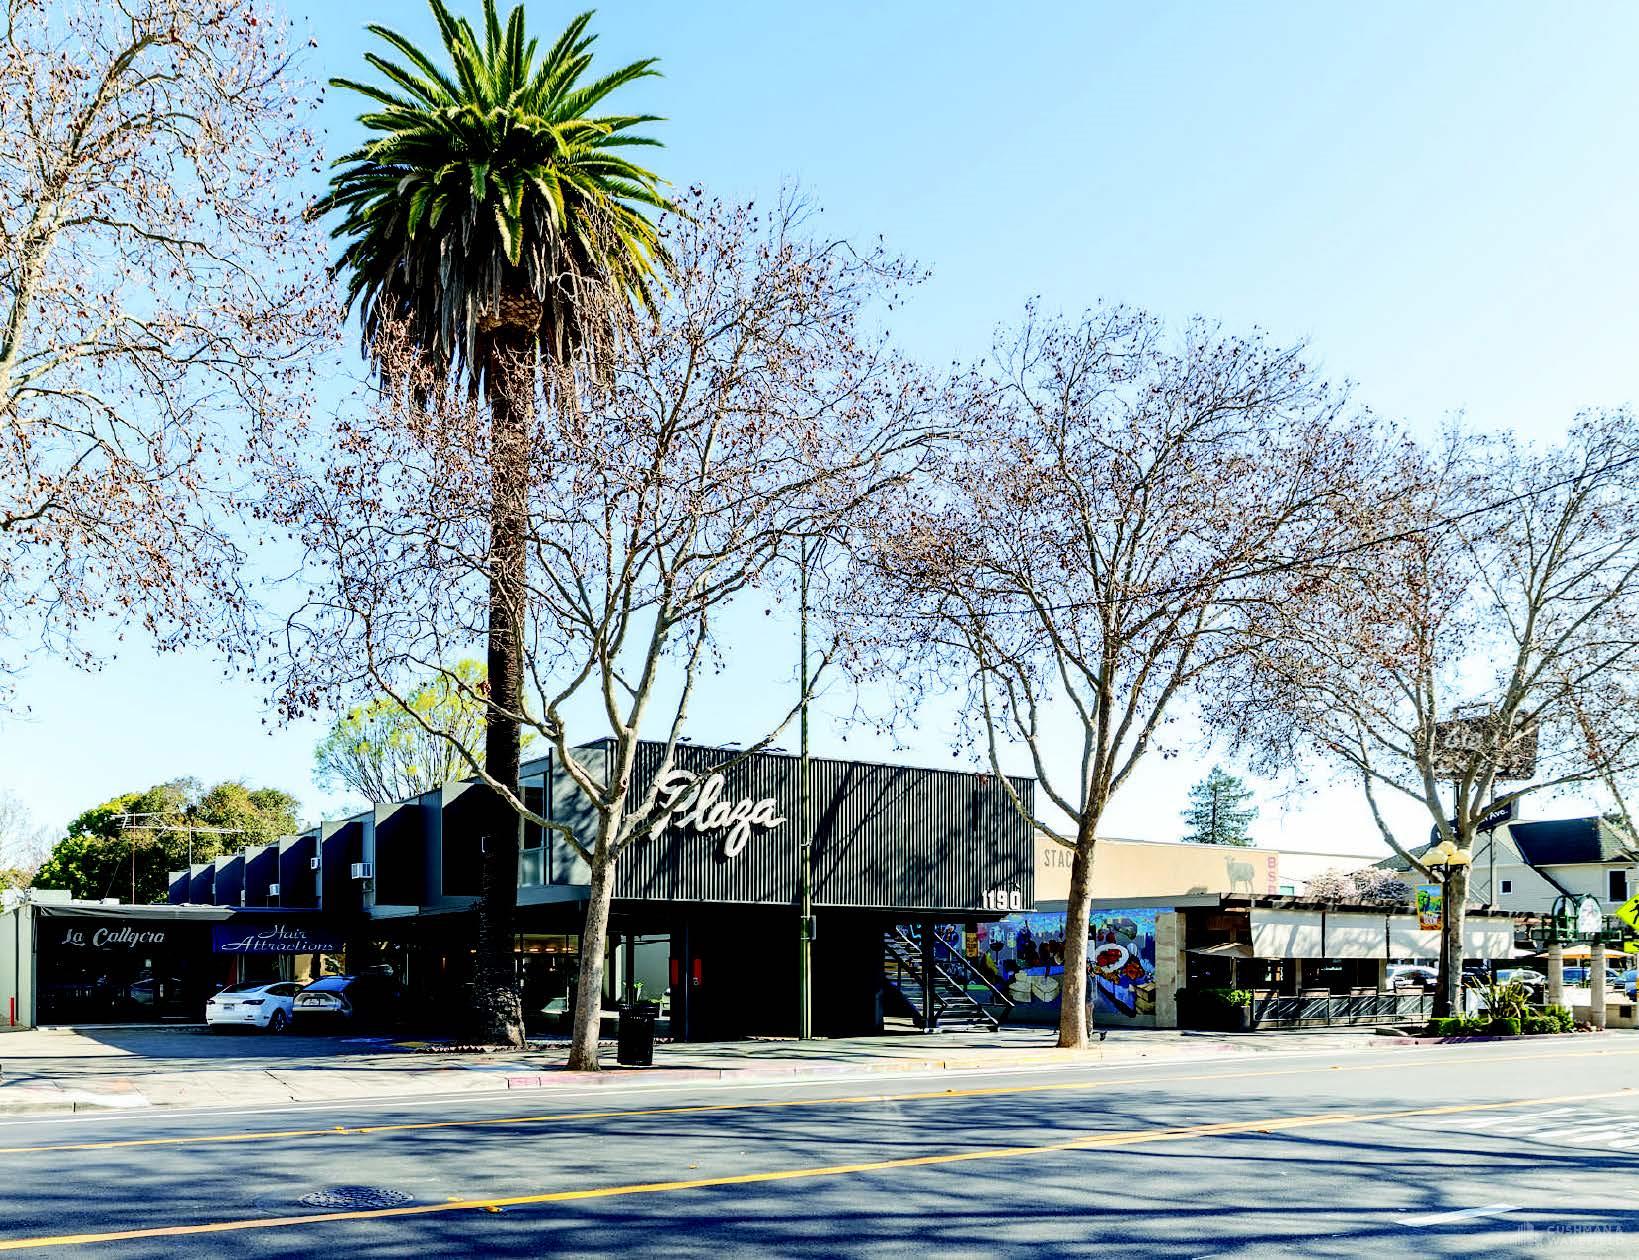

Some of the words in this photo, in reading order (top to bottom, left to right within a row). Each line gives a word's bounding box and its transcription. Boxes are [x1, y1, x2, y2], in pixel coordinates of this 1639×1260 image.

[649, 769, 787, 857] Plaza
[1043, 849, 1073, 868] STAC
[982, 889, 1021, 910] 1190
[61, 928, 86, 947] La
[257, 924, 308, 939] Hair
[221, 936, 334, 952] Attractions
